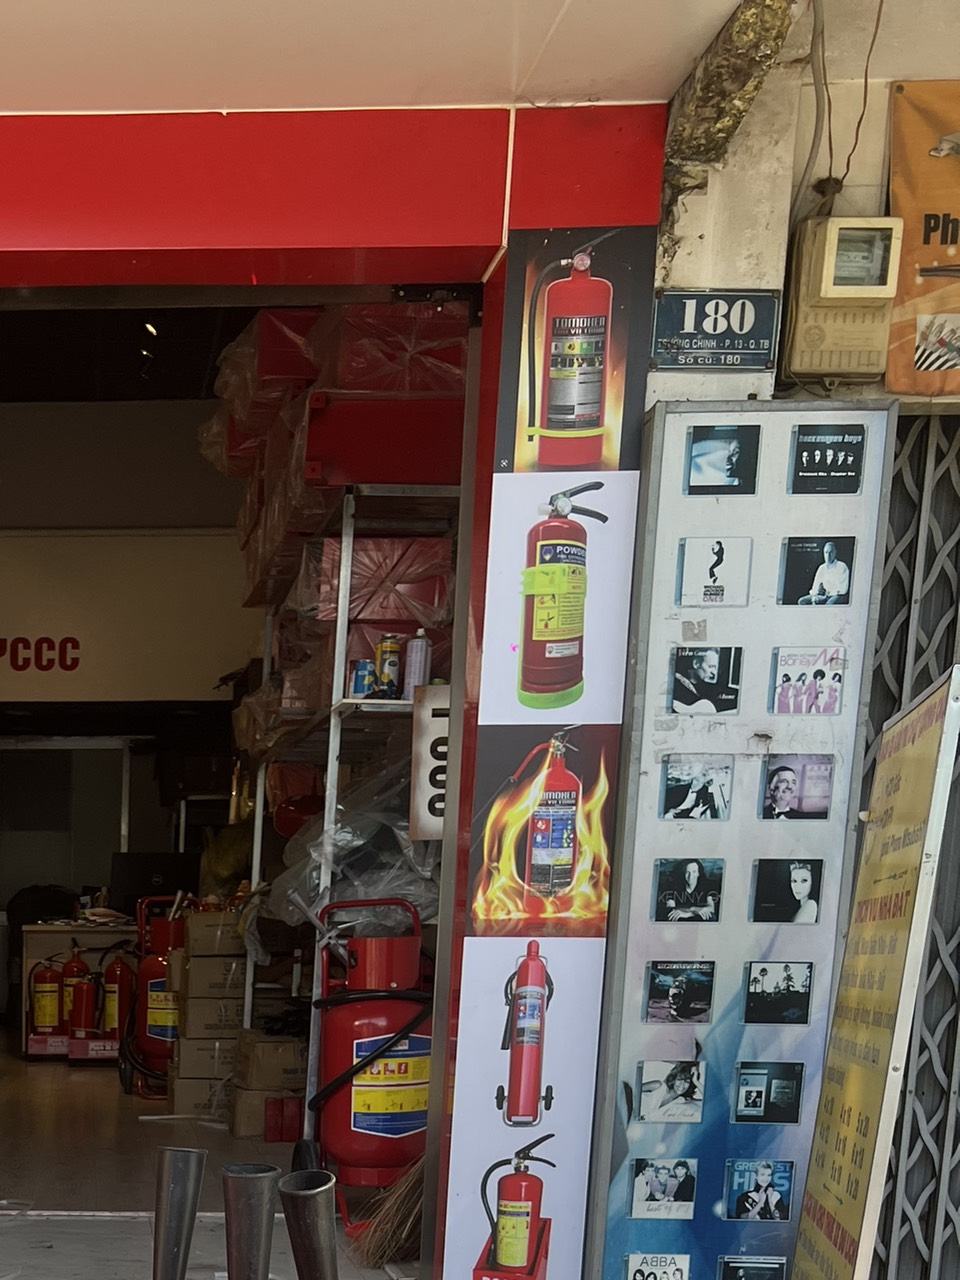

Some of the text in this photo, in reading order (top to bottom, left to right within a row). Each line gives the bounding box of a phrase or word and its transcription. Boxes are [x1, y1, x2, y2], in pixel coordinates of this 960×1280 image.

[680, 299, 756, 335] 180
[720, 354, 741, 364] 180
[640, 1256, 678, 1268] ABBA
